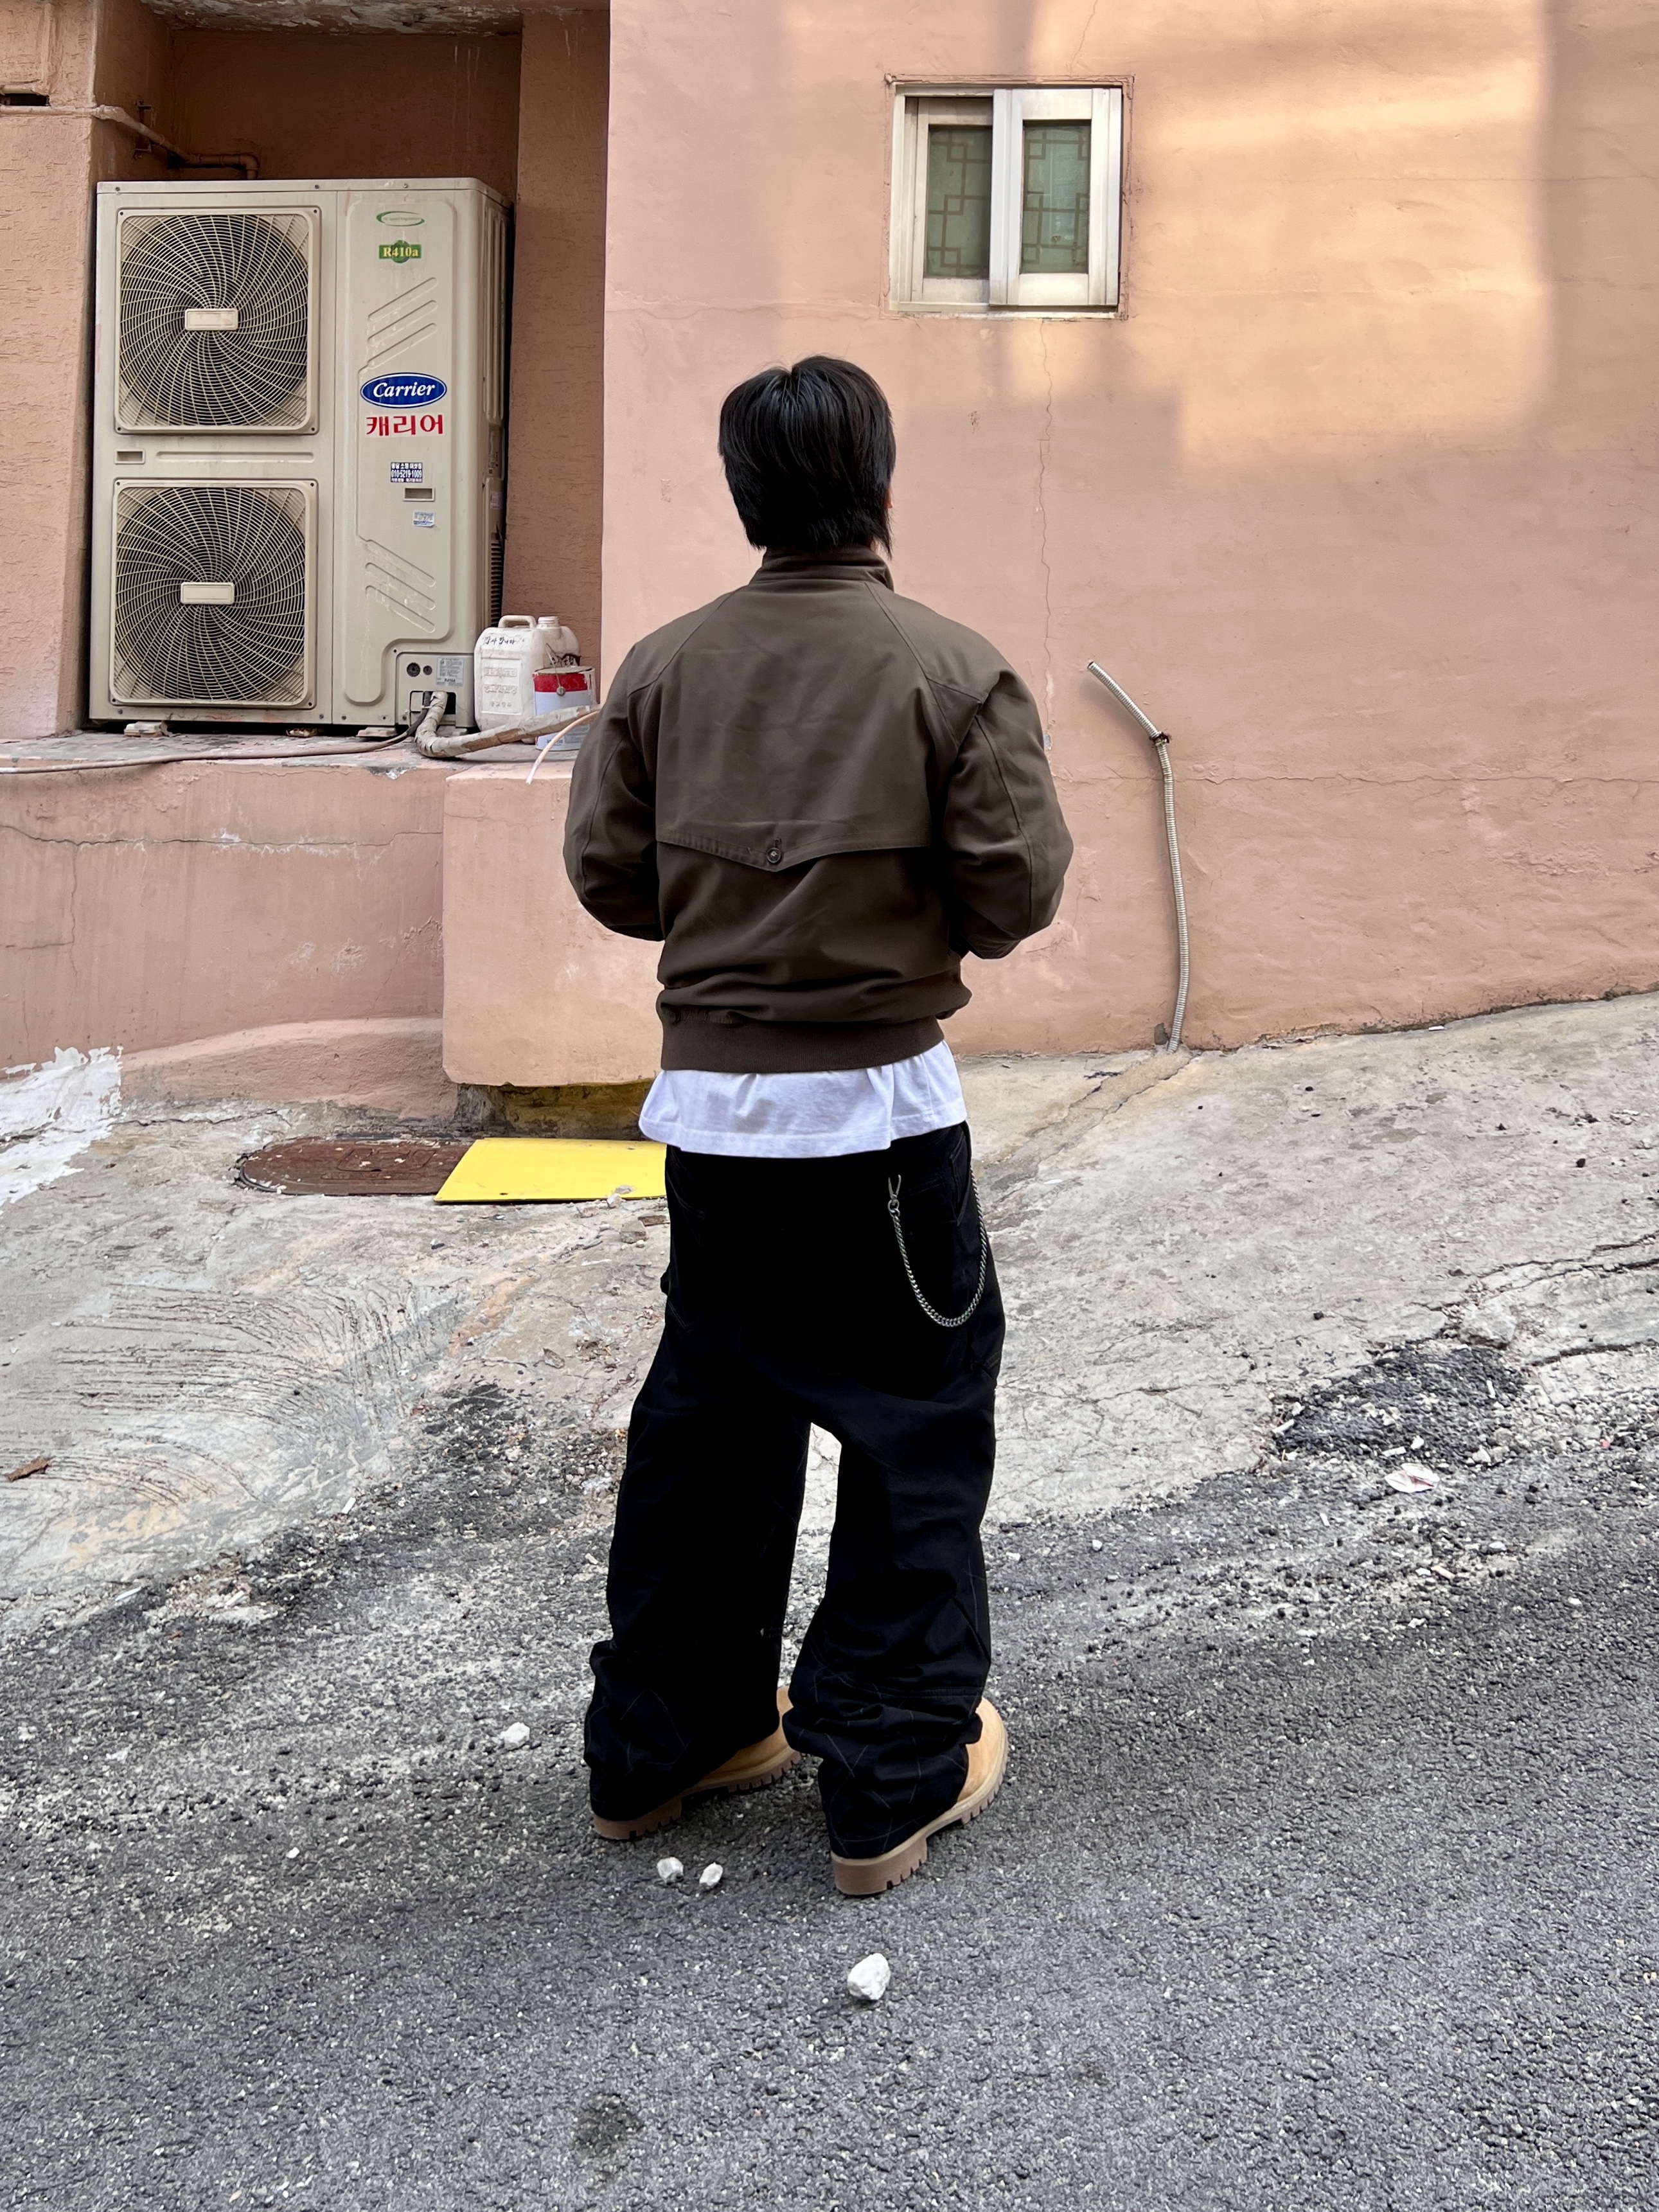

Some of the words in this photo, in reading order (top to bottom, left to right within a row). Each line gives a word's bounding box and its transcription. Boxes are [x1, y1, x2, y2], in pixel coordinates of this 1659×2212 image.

[383, 247, 419, 257] R410a
[373, 382, 436, 398] Carrier
[366, 415, 443, 436] 캐리어
